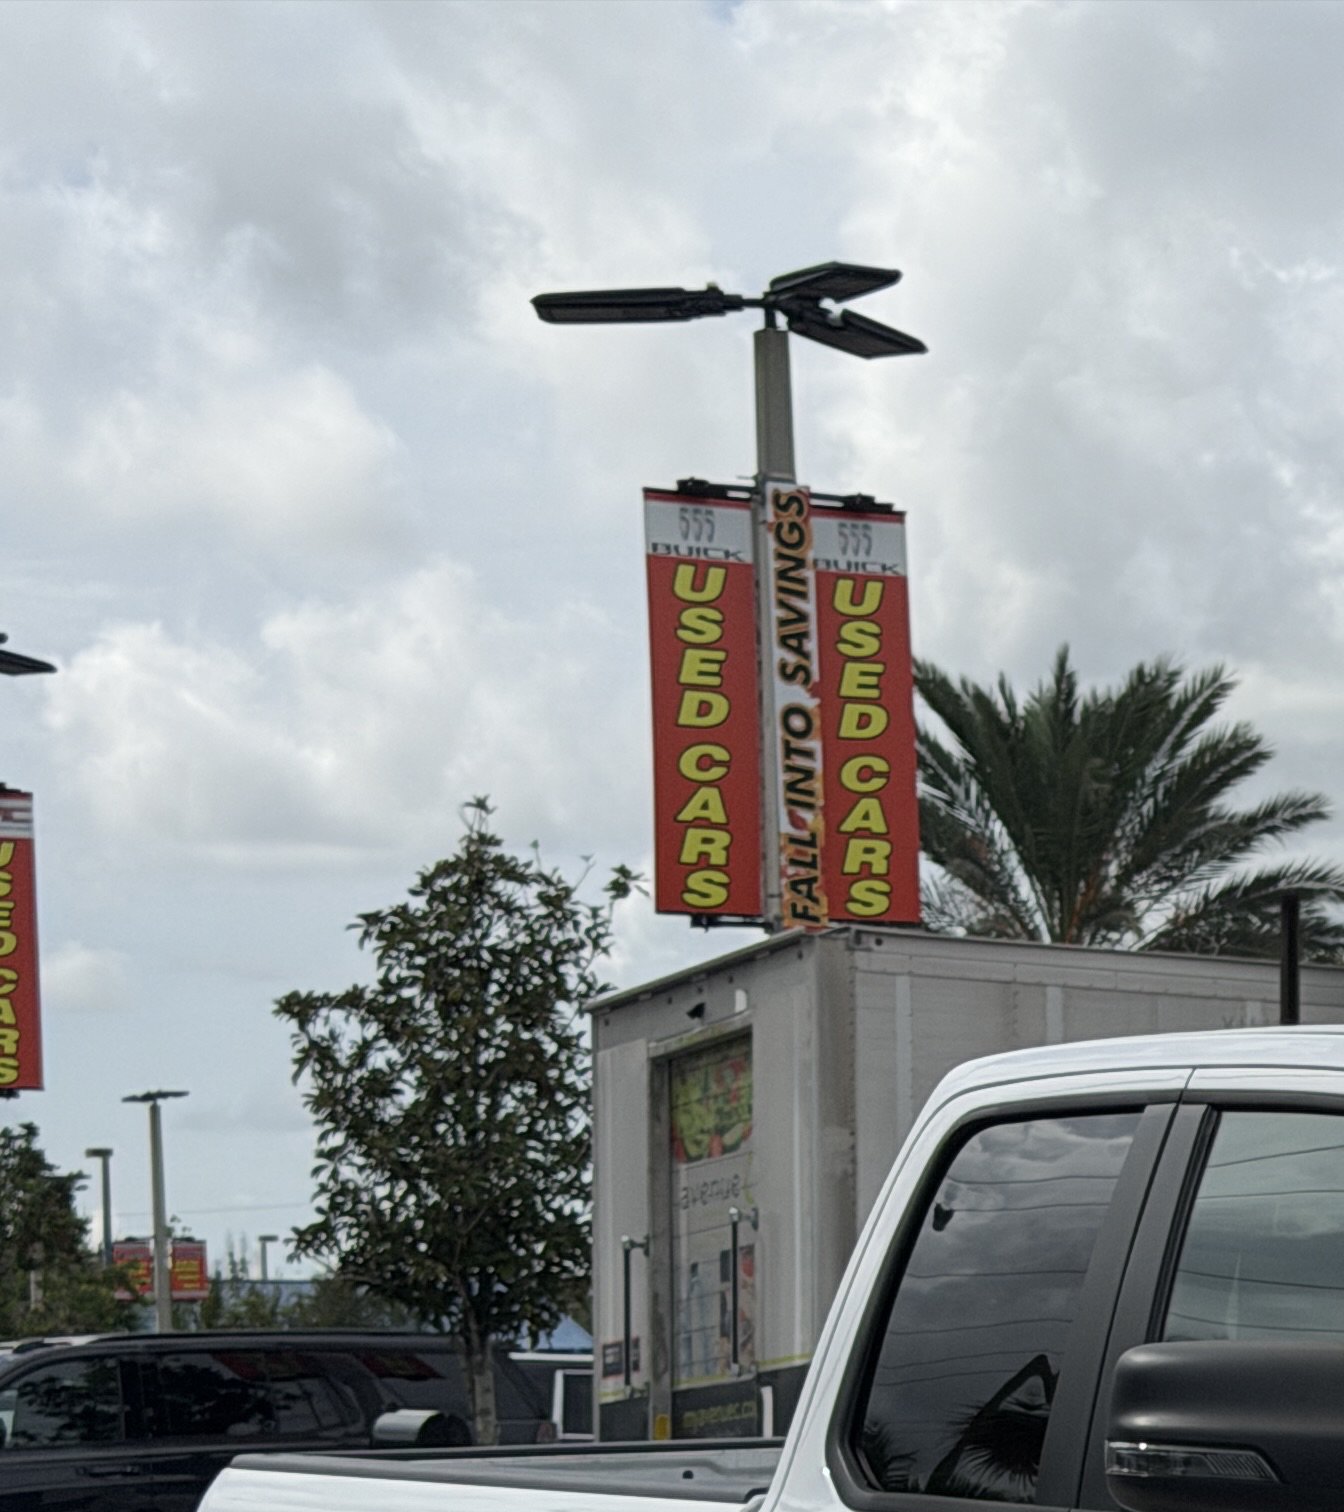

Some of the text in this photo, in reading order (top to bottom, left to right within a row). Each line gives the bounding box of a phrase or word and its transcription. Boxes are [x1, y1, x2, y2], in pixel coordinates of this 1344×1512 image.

[672, 562, 733, 910] USED CARS
[772, 487, 821, 924] FALL INTO SAVINGS
[832, 576, 893, 918] USED CARS
